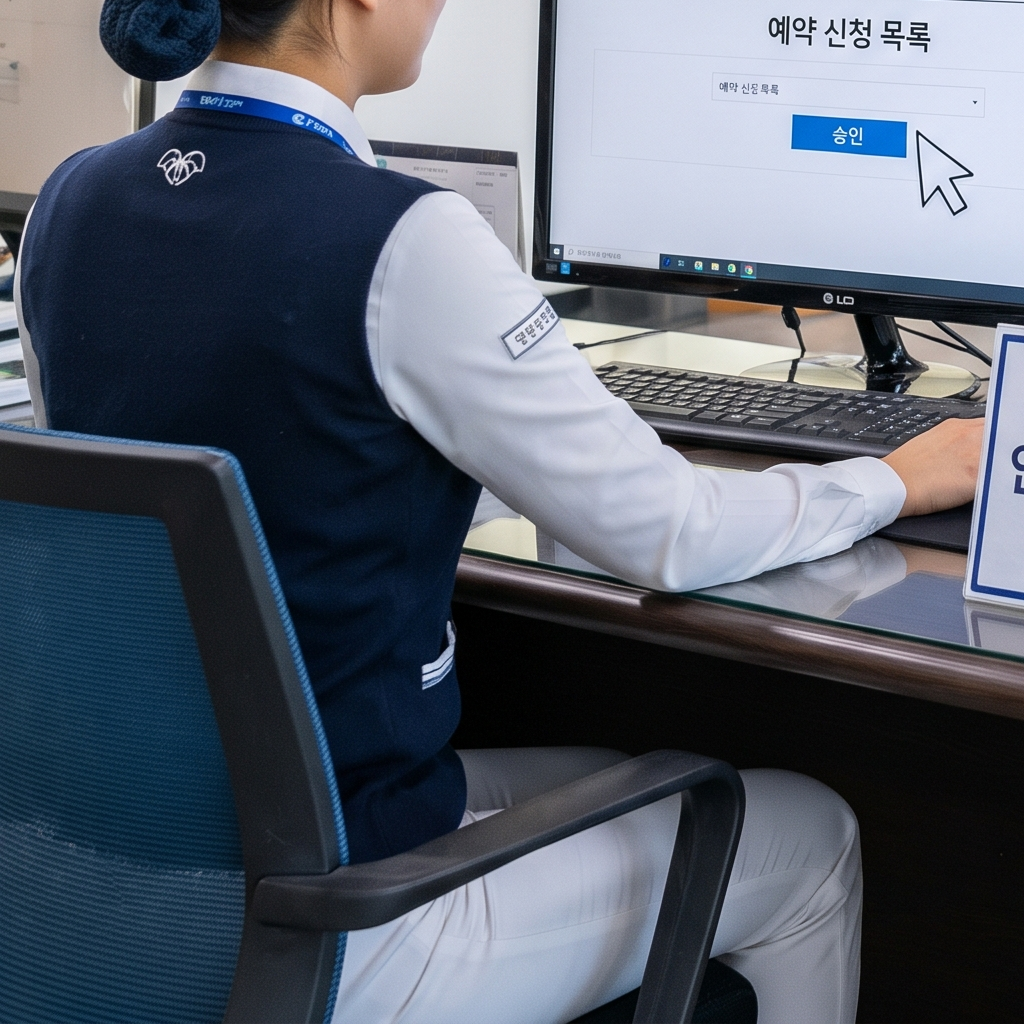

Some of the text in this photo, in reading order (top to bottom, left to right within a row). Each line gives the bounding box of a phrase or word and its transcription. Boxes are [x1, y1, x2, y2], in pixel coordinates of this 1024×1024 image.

[768, 15, 931, 53] 예약 신청 목록
[832, 126, 863, 146] 승인
